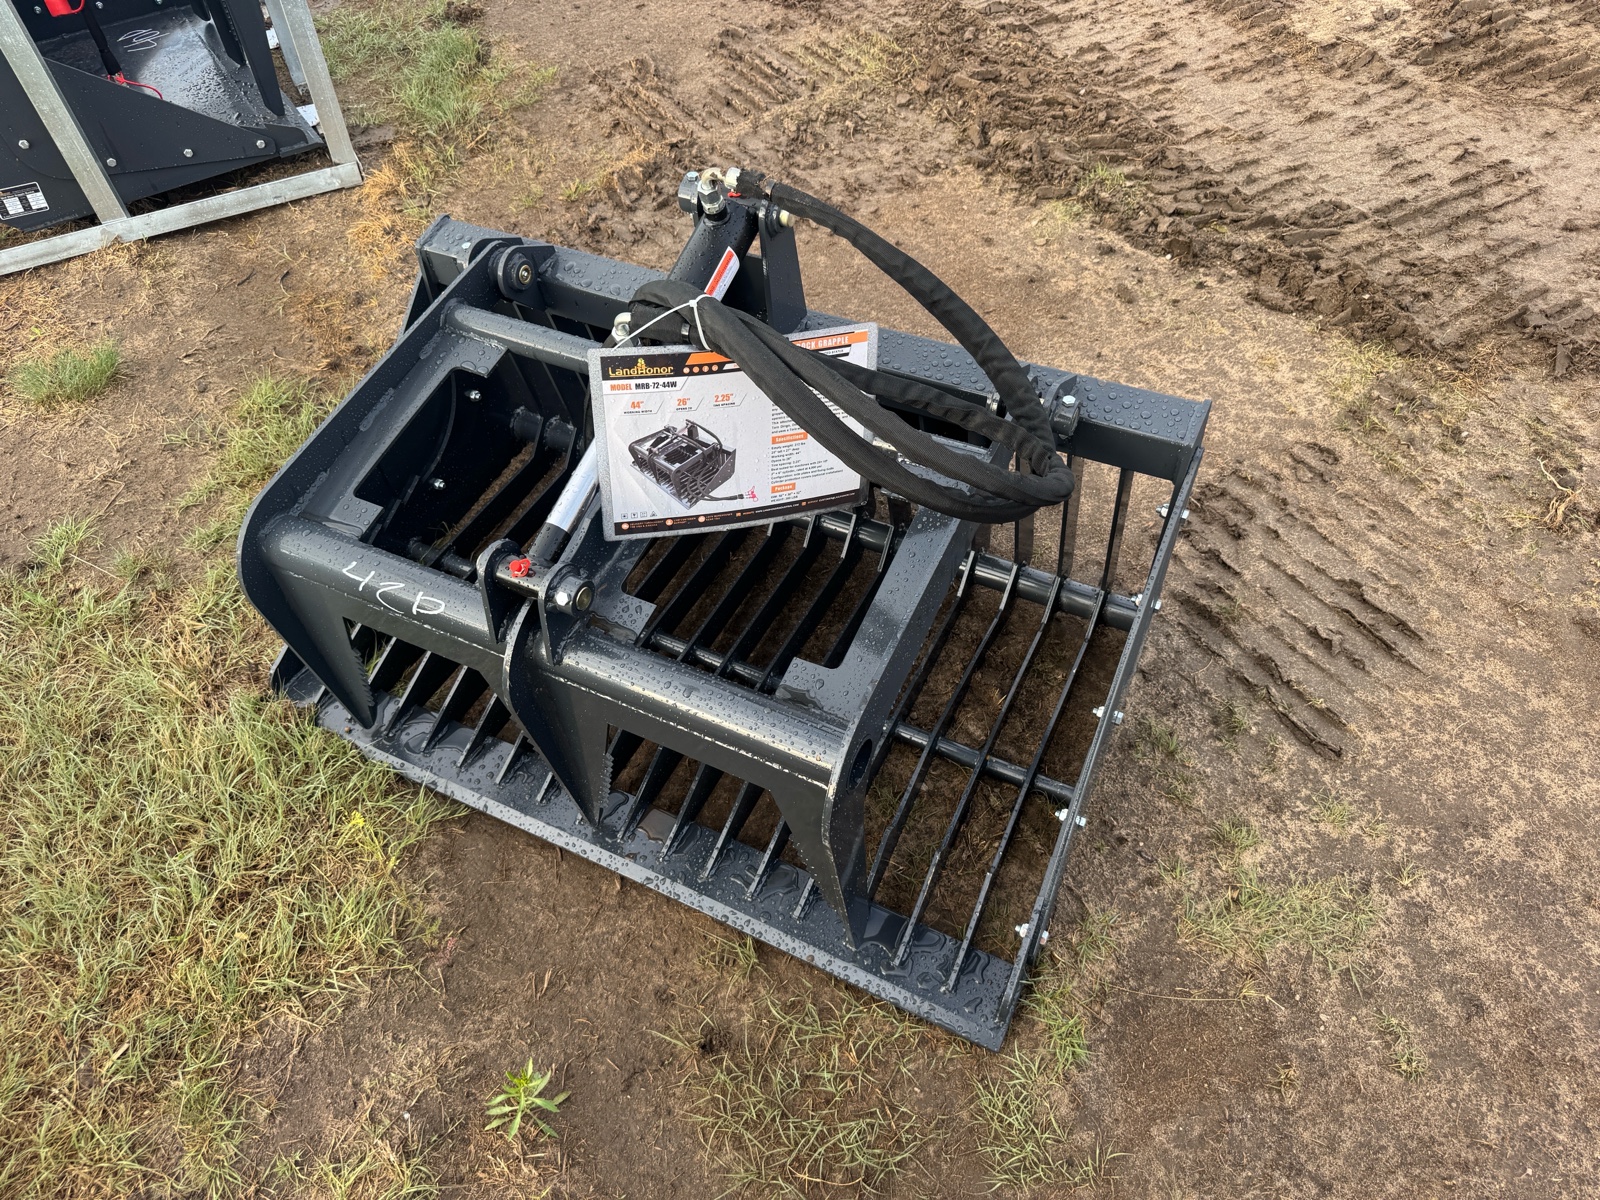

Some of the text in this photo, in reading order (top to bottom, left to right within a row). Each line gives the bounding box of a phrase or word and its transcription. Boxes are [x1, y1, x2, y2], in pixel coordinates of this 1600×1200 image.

[818, 336, 848, 347] GRAPPLE
[608, 366, 674, 376] LandHonor
[610, 381, 677, 391] MODEL MRB-72-44W
